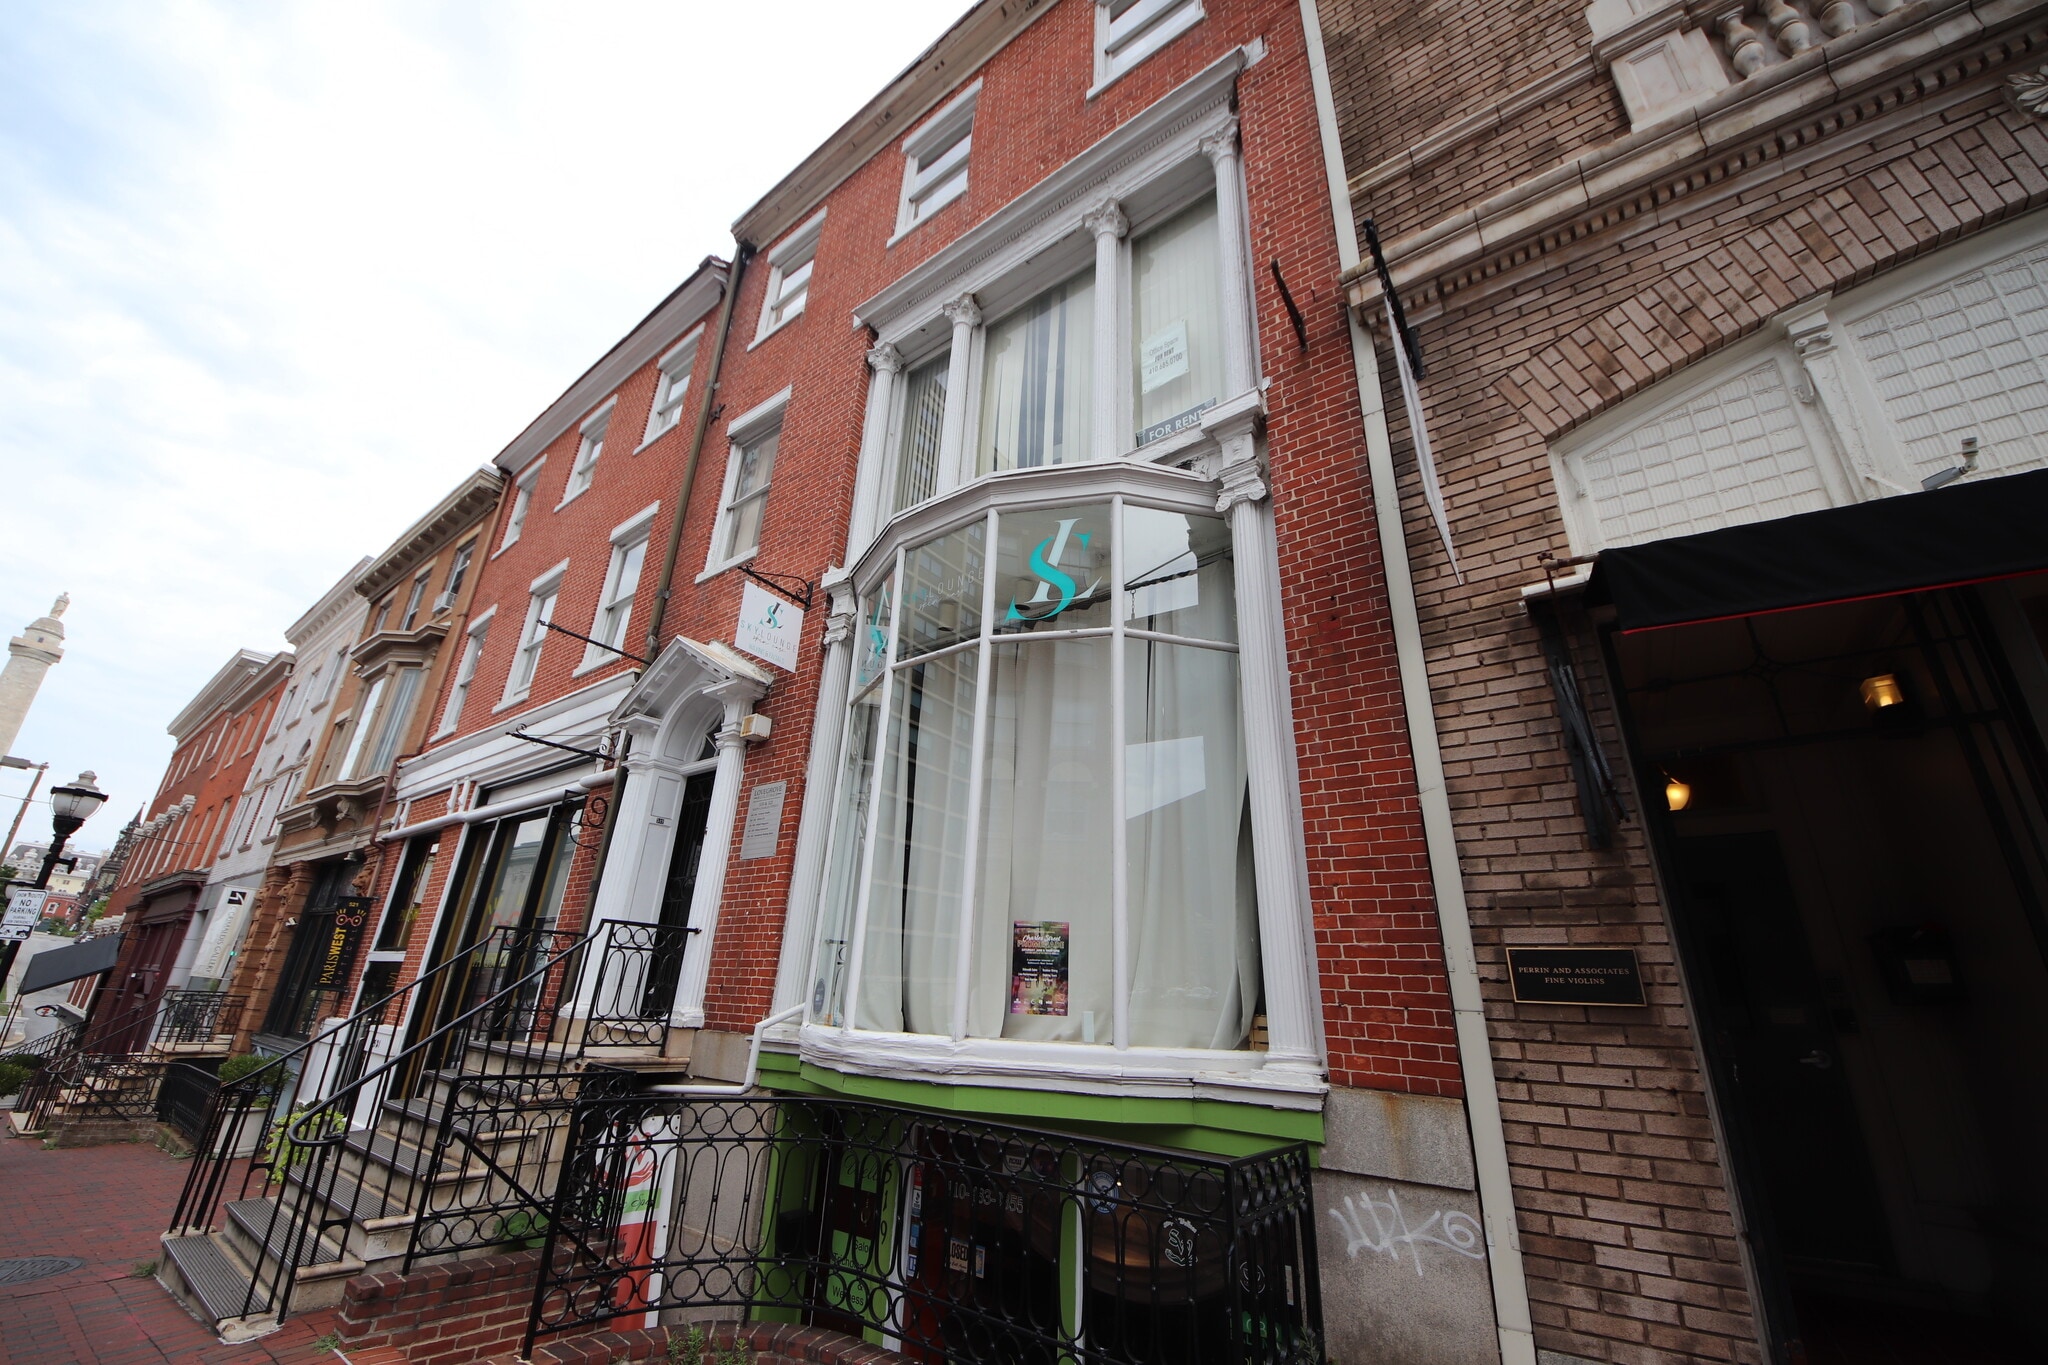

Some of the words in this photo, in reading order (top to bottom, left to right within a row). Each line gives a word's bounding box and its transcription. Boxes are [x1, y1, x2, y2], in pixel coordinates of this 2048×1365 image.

[1149, 424, 1172, 441] FOR
[1175, 409, 1203, 429] RENT
[19, 899, 32, 907] NO
[10, 907, 37, 915] PARKING
[205, 944, 222, 973] GALLERY
[319, 927, 347, 984] PARISWEST
[1518, 966, 1550, 974] PERRIN
[1574, 967, 1630, 975] ASSOCIATES
[1568, 977, 1605, 985] VIOLINS
